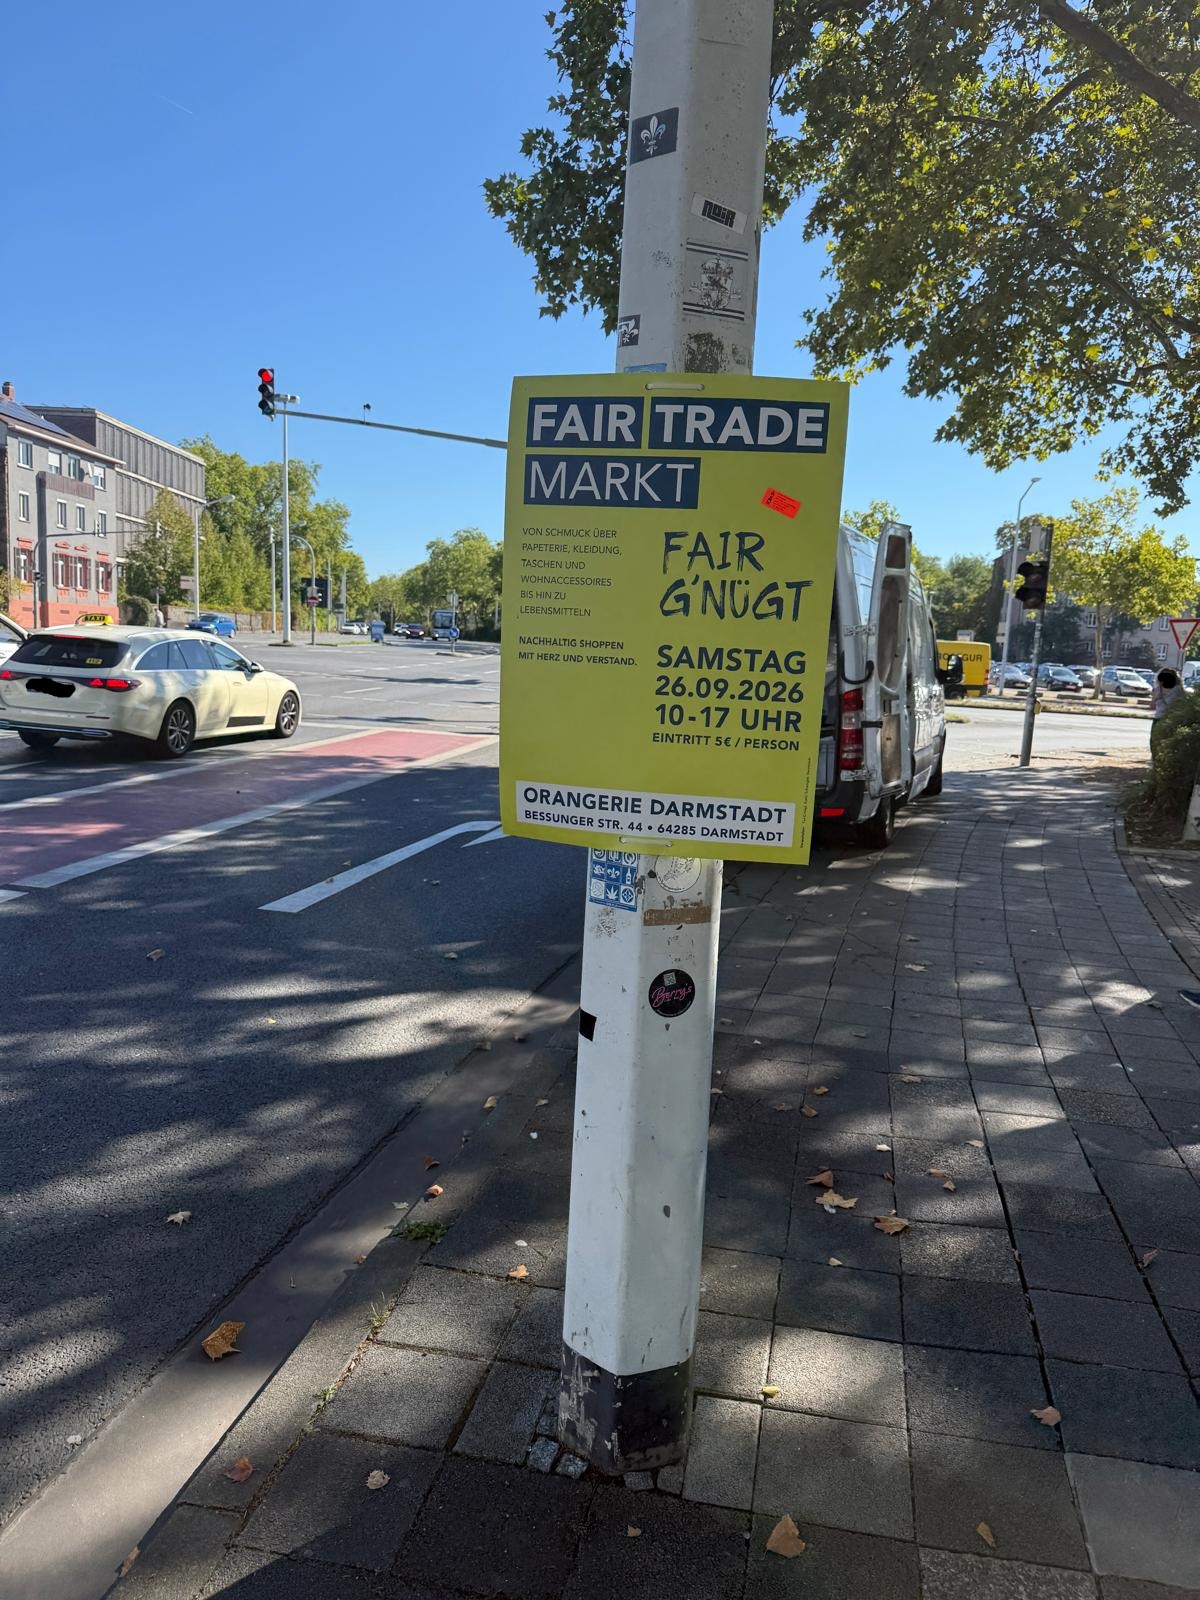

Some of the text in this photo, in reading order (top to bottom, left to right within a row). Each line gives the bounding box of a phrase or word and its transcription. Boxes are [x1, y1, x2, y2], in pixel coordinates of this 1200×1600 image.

[532, 404, 825, 447] FAIR TRADE
[529, 461, 695, 502] MARKT
[522, 527, 617, 538] VON SCHMUCK ÜBER
[522, 543, 622, 556] PAPETERIE, KLEIDUNG,
[662, 531, 765, 574] FAIR
[521, 559, 586, 570] TASCHEN UND
[521, 575, 612, 586] WOHNACCESSOIRES
[520, 590, 567, 600] BIS HIN ZU
[520, 606, 591, 616] LEBENSMITTELN
[519, 636, 624, 649] NACHHALTIG SHOPPEN
[518, 652, 638, 666] MIT HERZ UND VERSTAND.
[657, 645, 806, 674] SAMSTAG
[655, 675, 804, 703] 26.09.2026
[741, 709, 801, 732] UHR
[652, 732, 711, 745] EINTRITT
[714, 736, 732, 747] 5€
[744, 738, 800, 751] PERSON
[524, 787, 786, 823] ORANGERIE DARMSTADT
[525, 810, 593, 827] BESSUNGER
[598, 818, 623, 830] STR.
[628, 822, 643, 832] 44
[657, 823, 696, 835] 64285
[701, 827, 783, 842] DARMSTADT
